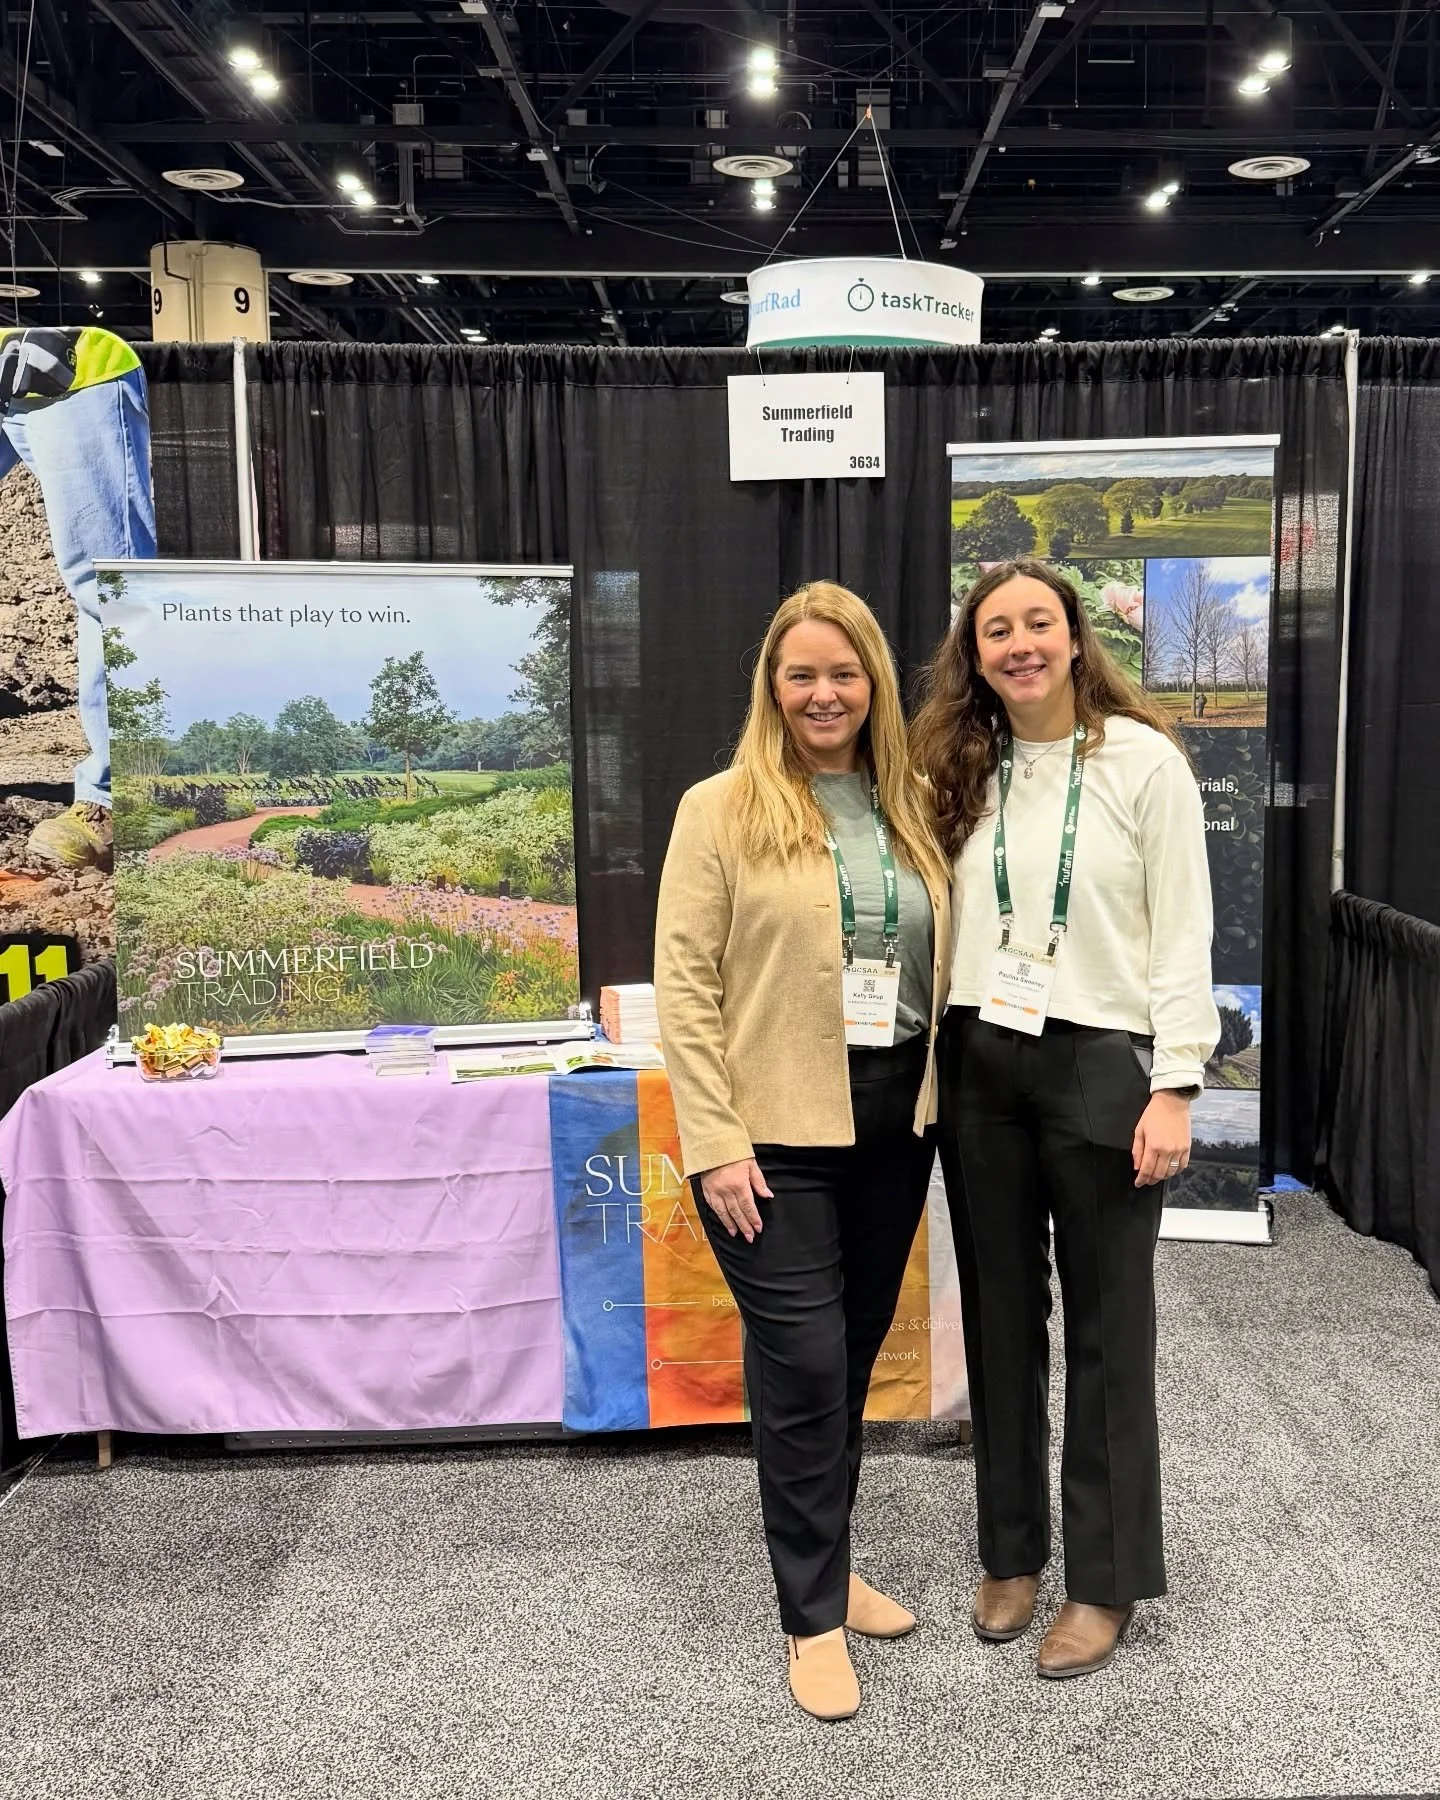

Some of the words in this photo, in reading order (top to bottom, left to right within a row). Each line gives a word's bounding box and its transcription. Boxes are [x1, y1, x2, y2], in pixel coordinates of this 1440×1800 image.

[153, 288, 163, 315] 9
[234, 287, 250, 314] 9
[881, 291, 975, 323] taskTracker
[762, 405, 853, 421] Summerfield
[781, 427, 834, 443] Trading
[850, 456, 880, 469] 3634
[162, 603, 232, 622] Plants
[238, 604, 283, 623] that
[290, 604, 334, 628] play
[339, 607, 362, 623] to
[368, 605, 411, 624] win.
[1073, 755, 1084, 787] nufarm
[876, 827, 888, 855] nufarm
[838, 864, 852, 896] nufarm
[1061, 850, 1074, 885] nufarm
[176, 943, 434, 979] SUMMERFIELD
[1007, 947, 1035, 959] GCSAA
[851, 966, 878, 974] GCSAA
[177, 975, 341, 1009] TRADING
[908, 1318, 920, 1331] &
